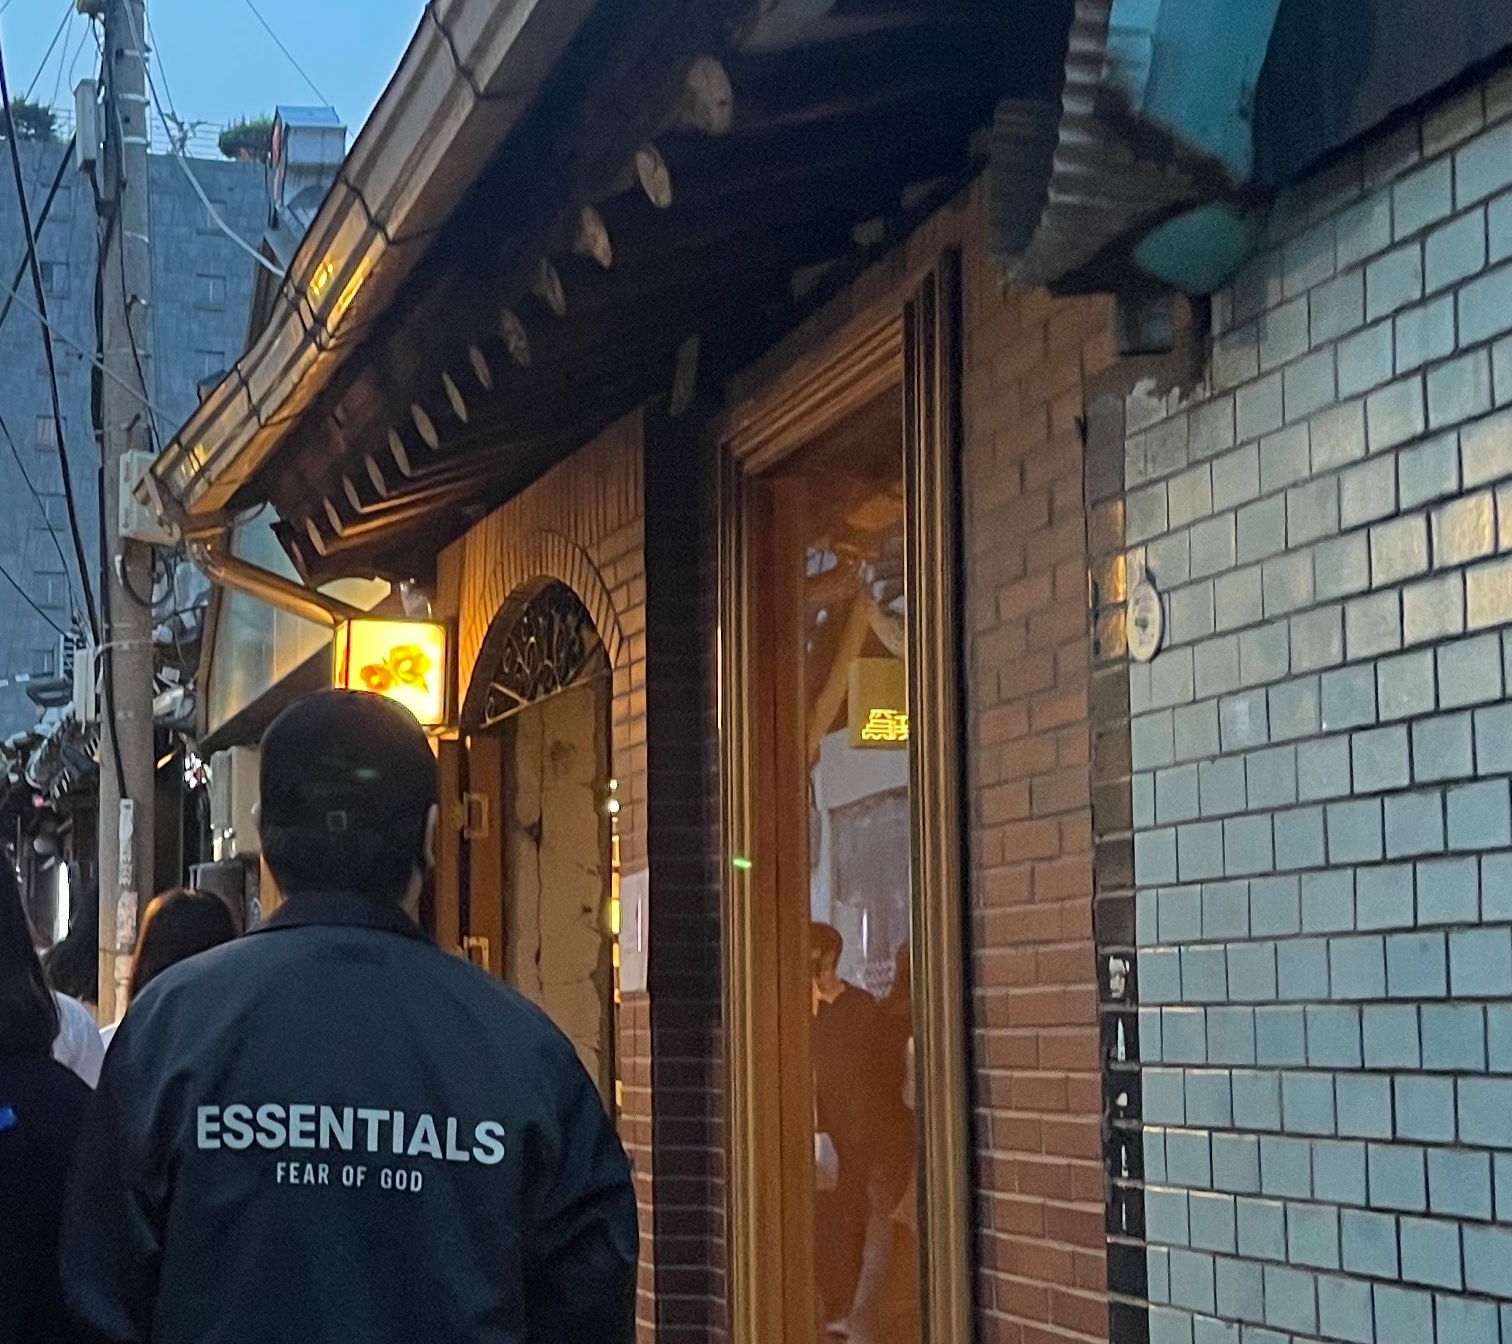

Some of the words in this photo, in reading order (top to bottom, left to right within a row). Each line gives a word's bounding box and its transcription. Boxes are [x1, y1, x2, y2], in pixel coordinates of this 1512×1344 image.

[197, 1103, 506, 1165] ESSENTIALS
[276, 1161, 330, 1185] FEAR
[342, 1165, 367, 1188] OF
[380, 1168, 423, 1192] GOD
